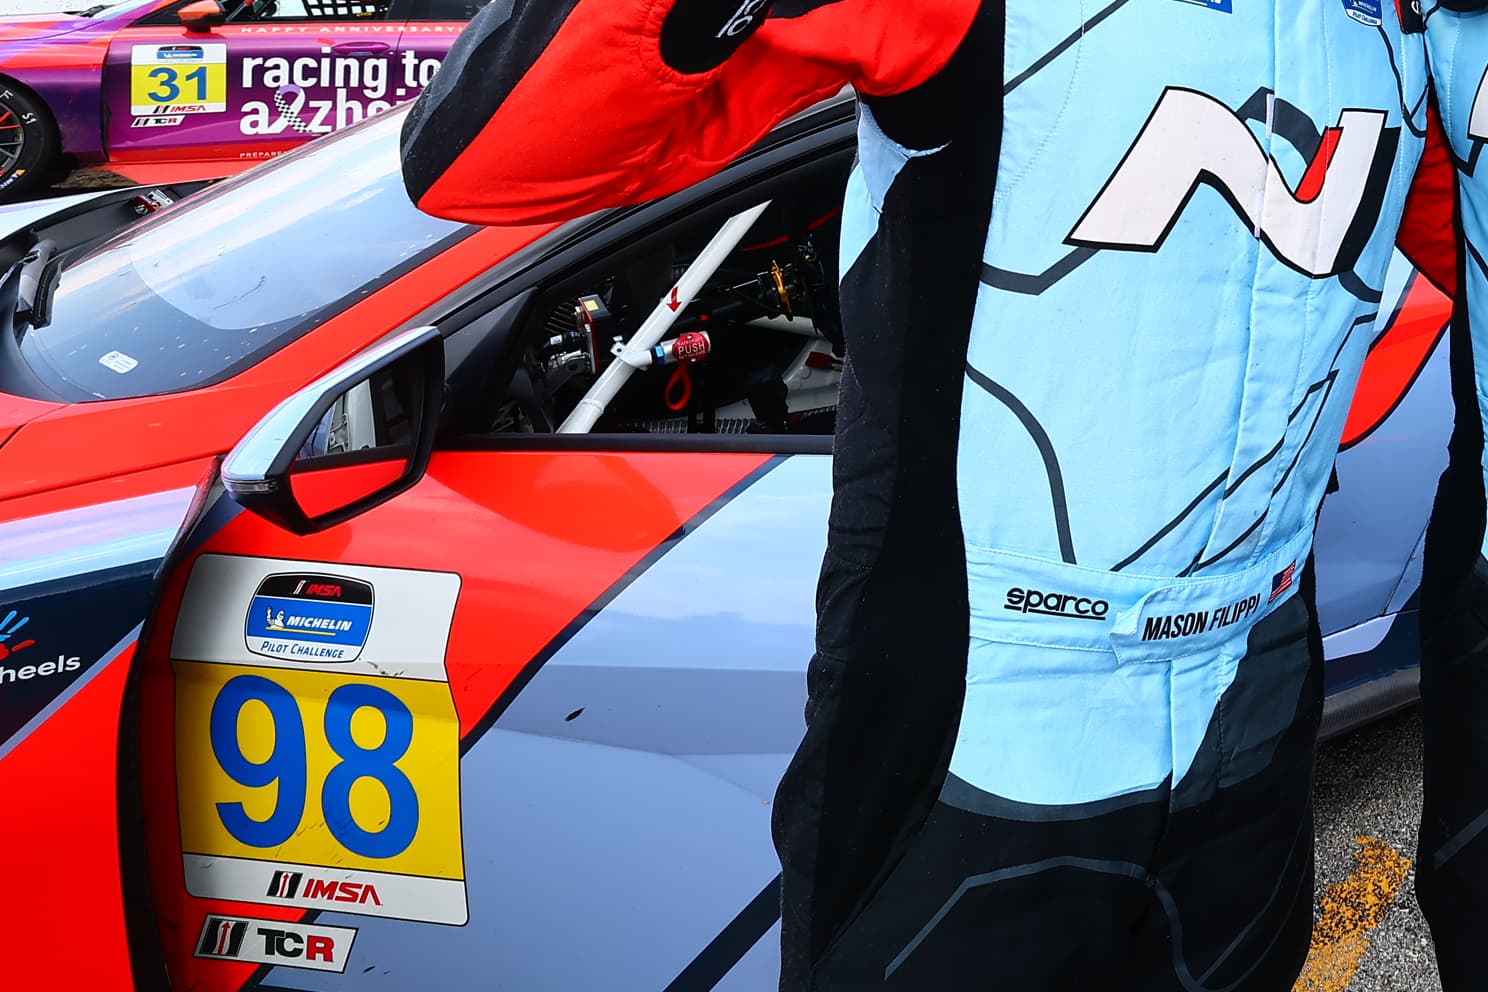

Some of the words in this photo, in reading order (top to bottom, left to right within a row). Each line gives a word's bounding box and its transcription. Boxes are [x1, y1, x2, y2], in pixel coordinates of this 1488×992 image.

[147, 66, 208, 103] 31
[241, 46, 388, 100] racing
[153, 117, 178, 125] TCR
[170, 104, 206, 113] IMSA
[678, 341, 706, 357] PUSH
[305, 583, 343, 598] IMSA
[1004, 587, 1109, 621] sparco
[286, 615, 353, 632] MICHELIN
[1141, 612, 1208, 642] MASON
[1209, 594, 1261, 632] FILIPPI
[260, 640, 289, 654] PILOT
[290, 643, 345, 659] CHALLENGE
[0, 654, 81, 685] heels
[210, 674, 420, 859] 98
[302, 877, 382, 906] IMSA
[257, 927, 335, 962] TCR
